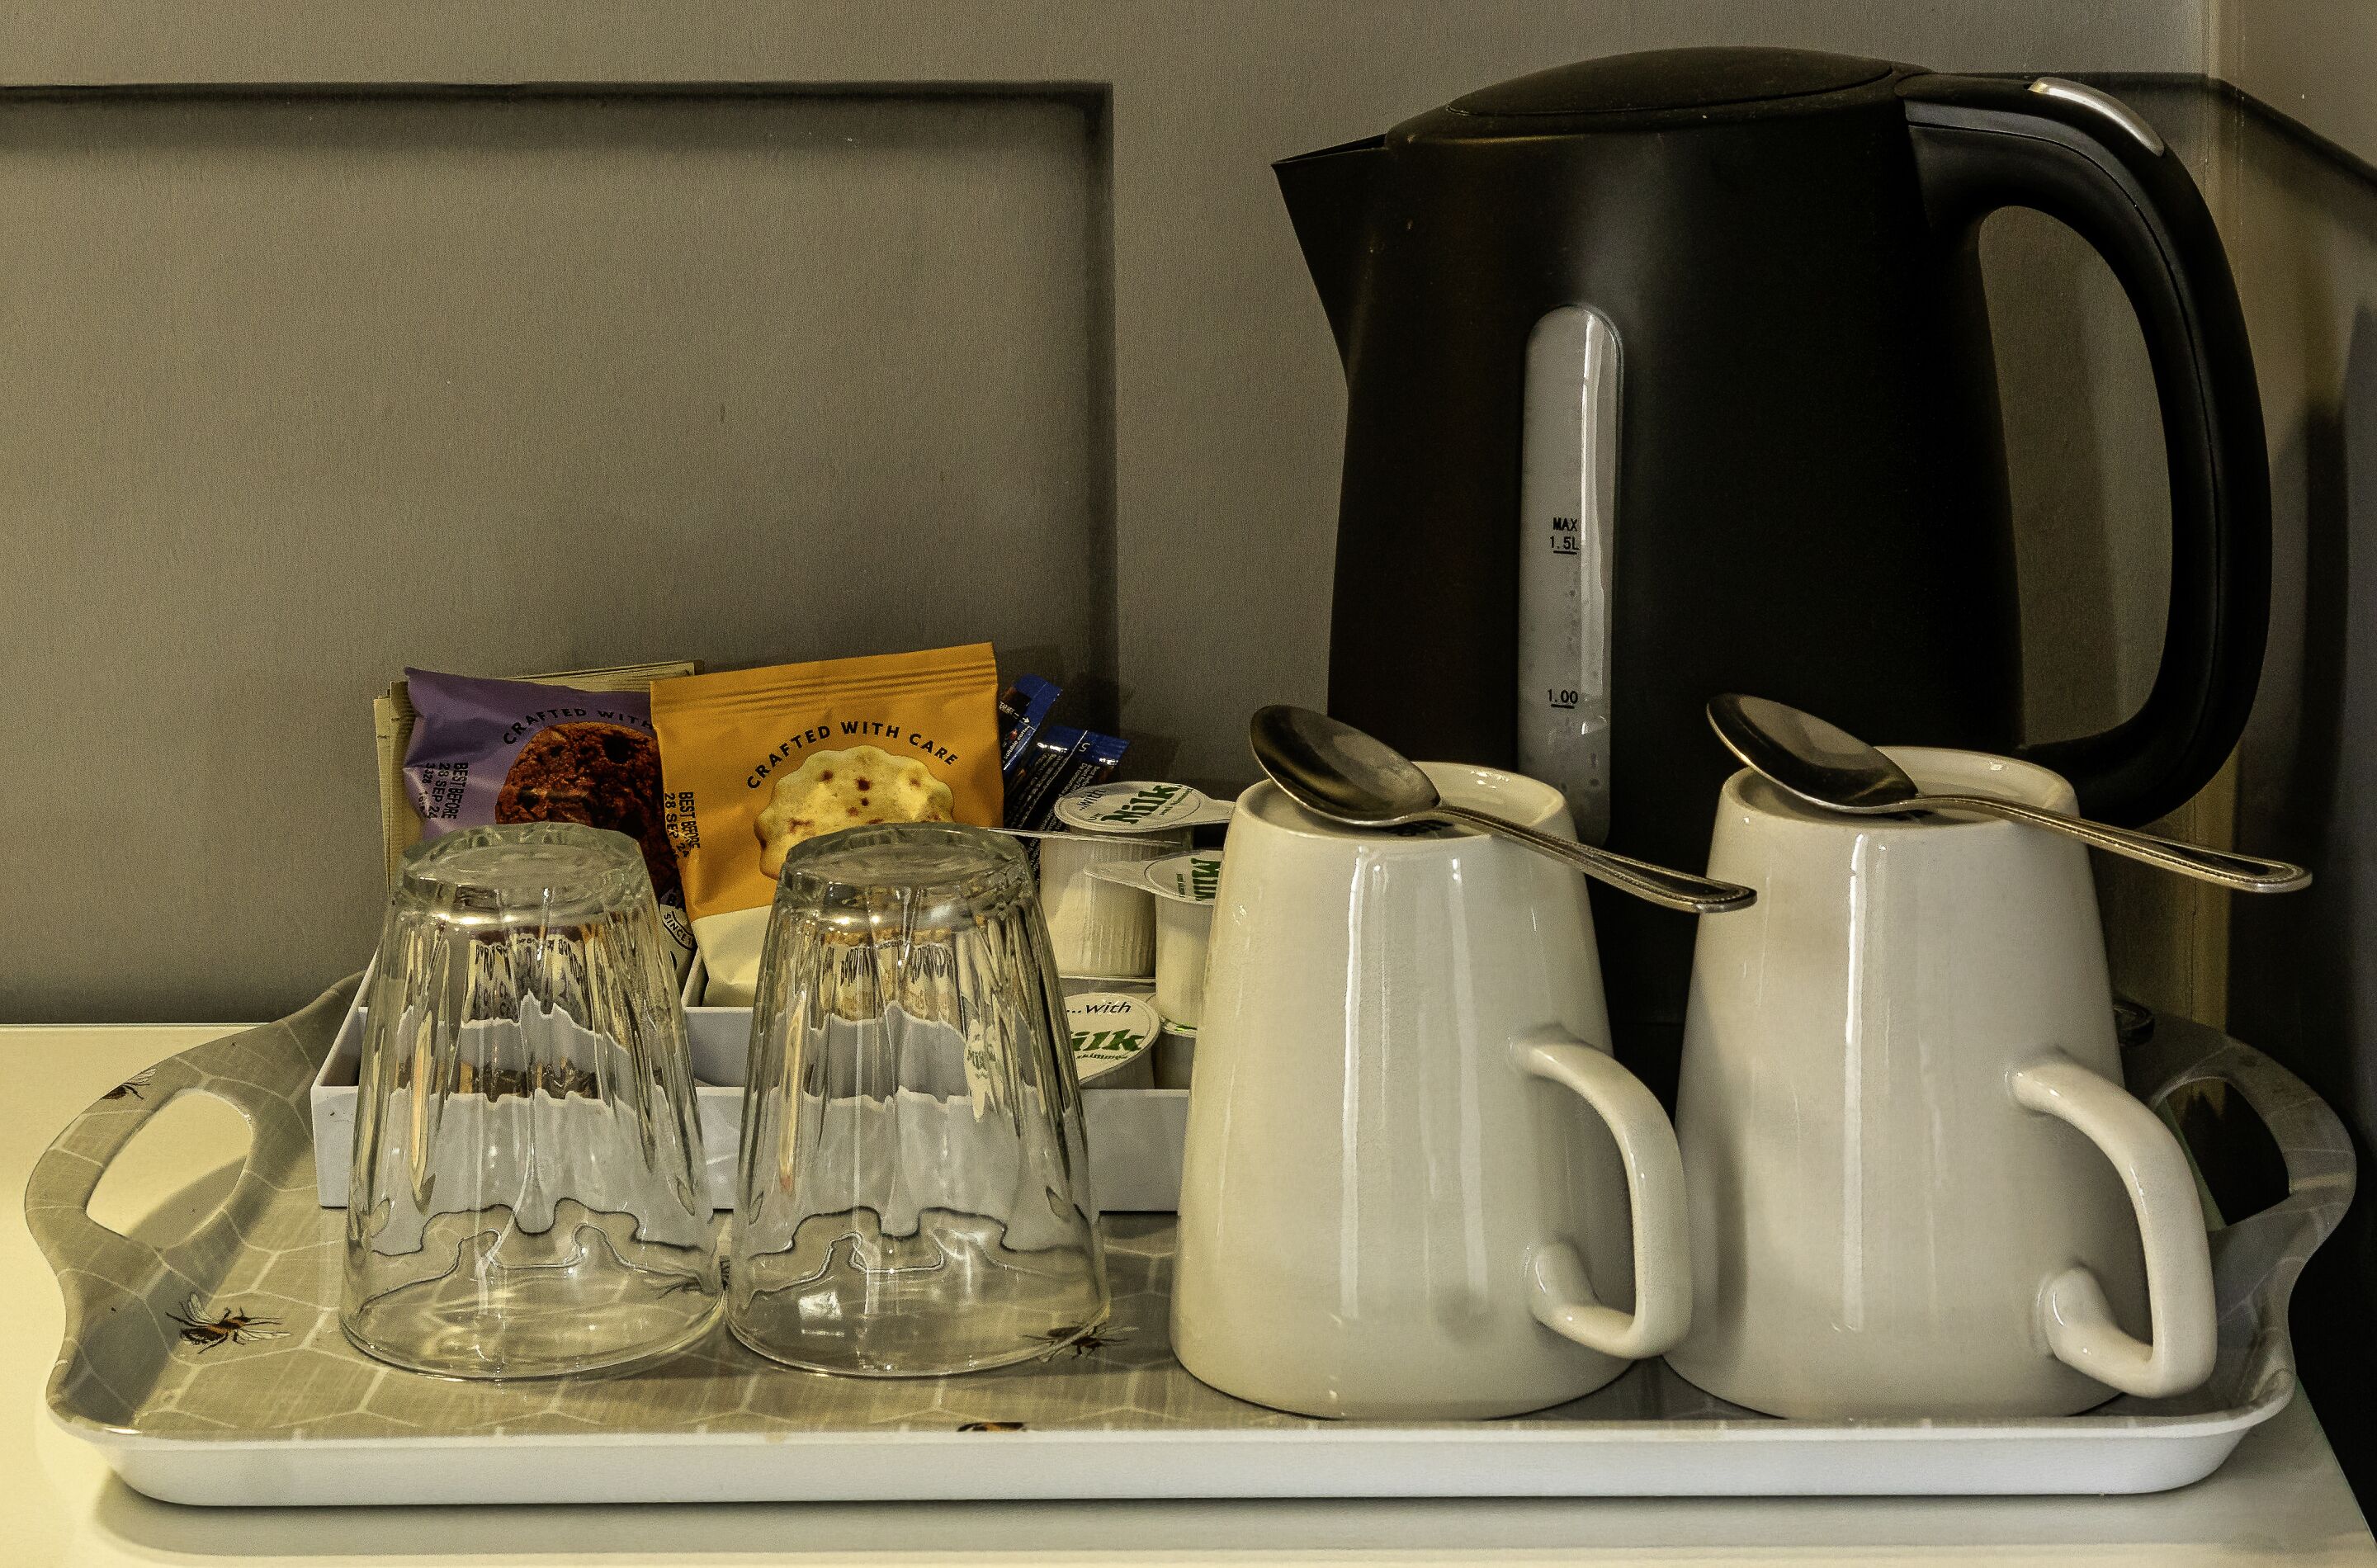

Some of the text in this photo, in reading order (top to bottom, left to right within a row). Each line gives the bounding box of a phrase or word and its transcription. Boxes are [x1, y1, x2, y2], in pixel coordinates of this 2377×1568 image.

[1553, 517, 1578, 531] MAX
[1550, 536, 1580, 550] 1.5L
[1548, 689, 1578, 704] 1.00
[503, 708, 654, 745] CRAFTED WITH
[746, 720, 958, 790] CRAFTED WITH CARE
[438, 762, 451, 777] 28
[432, 780, 447, 802] SEP
[441, 762, 469, 819] BEST BEFORE
[664, 792, 676, 809] 28
[1101, 785, 1182, 824] Milk
[678, 791, 700, 849] BEST BEFORE
[664, 913, 687, 942] SINCE
[1066, 1001, 1132, 1014] ...with
[1070, 1028, 1145, 1052] ilk
